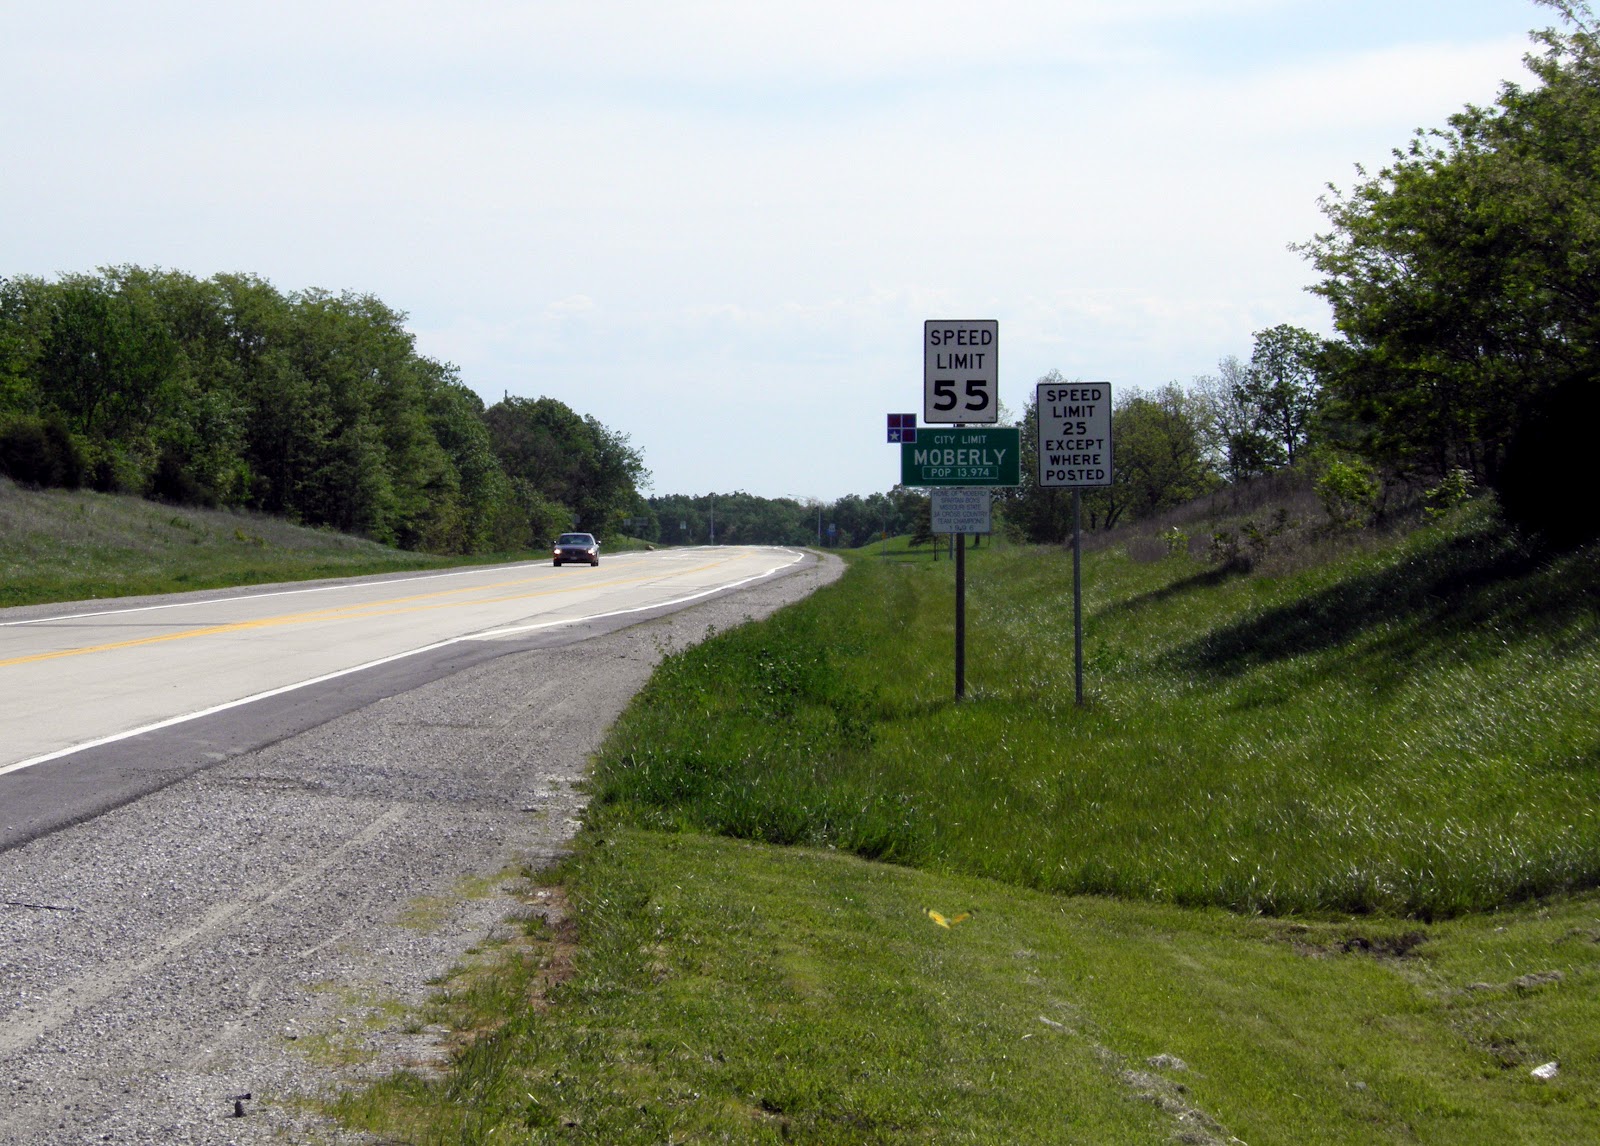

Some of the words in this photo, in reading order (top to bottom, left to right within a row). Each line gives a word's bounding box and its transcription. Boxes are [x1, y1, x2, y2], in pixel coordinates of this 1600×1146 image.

[930, 329, 992, 346] SPEED
[936, 353, 985, 370] LIMIT
[933, 379, 989, 411] 55
[1046, 388, 1102, 402] SPEED
[1053, 405, 1096, 418] LIMIT
[1062, 421, 1087, 435] 25
[934, 435, 956, 445] CITY
[961, 434, 987, 444] LIMIT
[1045, 438, 1104, 451] EXCEPT
[914, 448, 1007, 466] MOBERLY
[1049, 453, 1102, 466] WHERE
[931, 467, 952, 477] POP
[1046, 469, 1105, 481] POSTED
